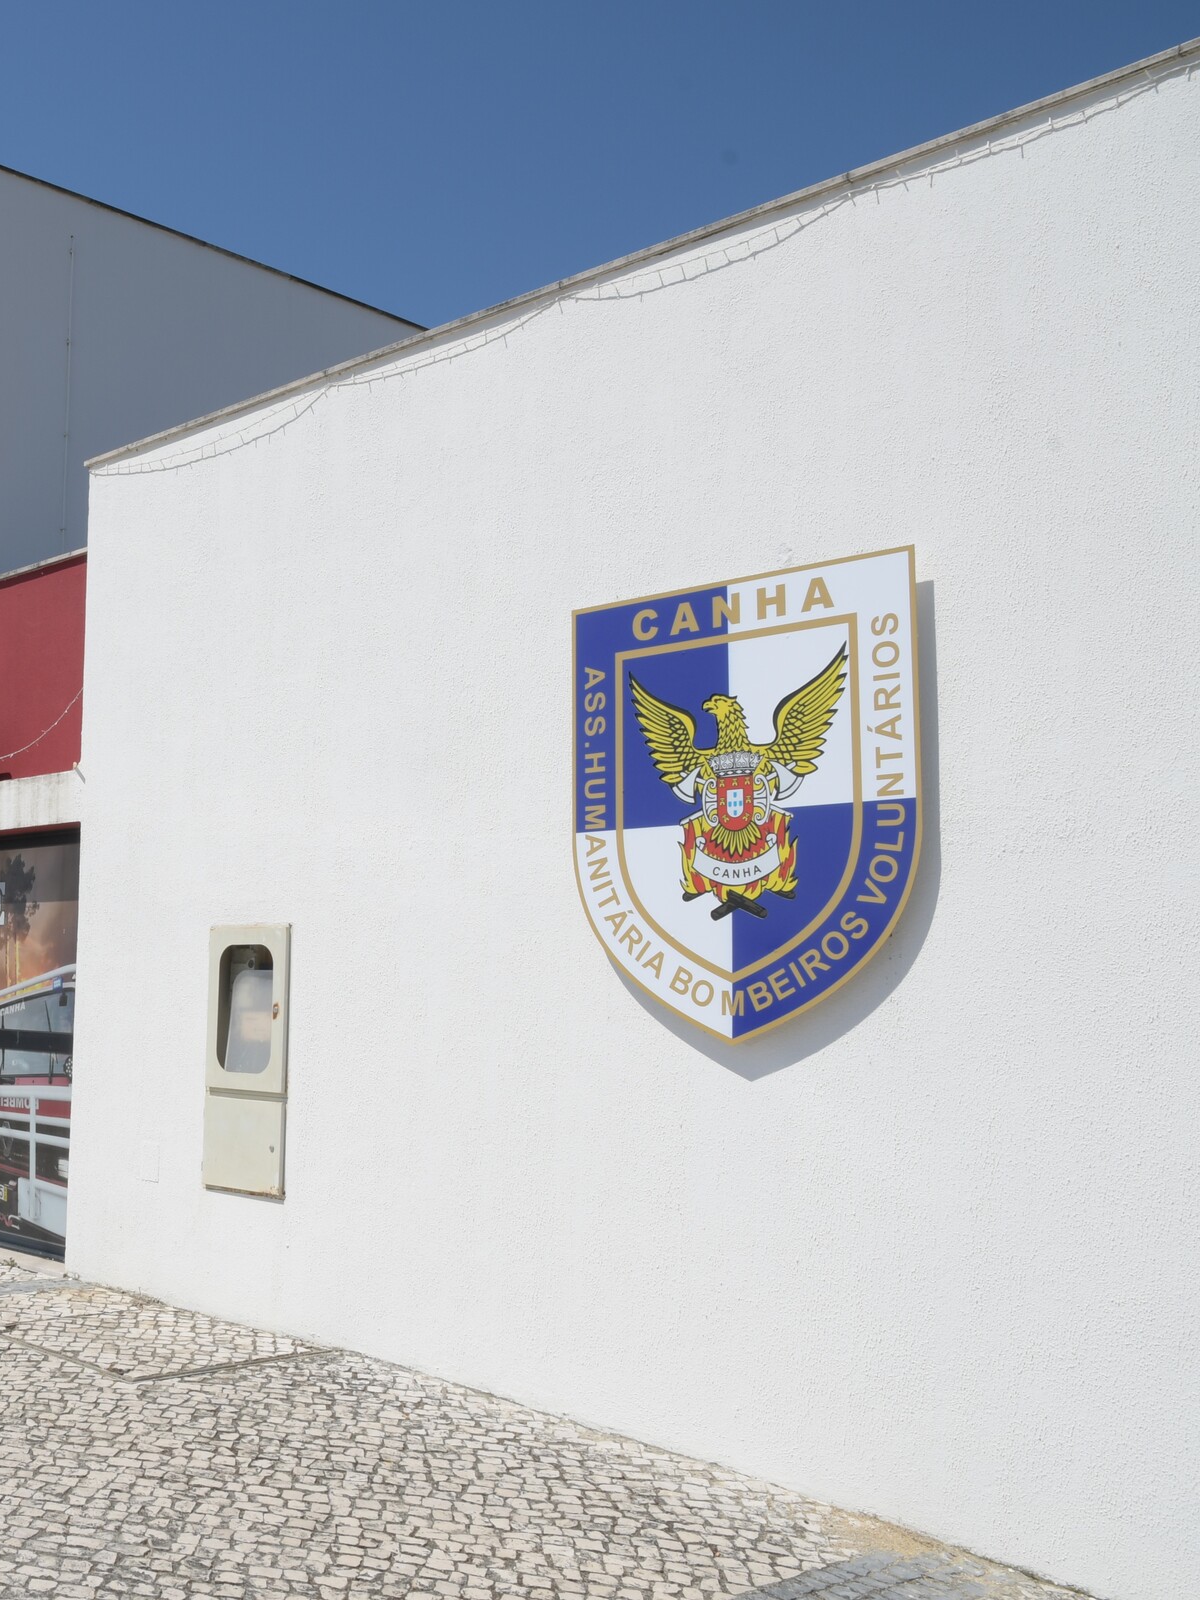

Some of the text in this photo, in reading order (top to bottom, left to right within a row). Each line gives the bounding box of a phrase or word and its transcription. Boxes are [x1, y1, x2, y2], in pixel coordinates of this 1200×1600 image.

[632, 576, 835, 641] CANHA
[669, 910, 869, 1017] BOMBEIROS
[857, 611, 905, 906] VOLUNTÁRIOS
[712, 865, 761, 879] CANHA
[0, 999, 26, 1017] CANHA
